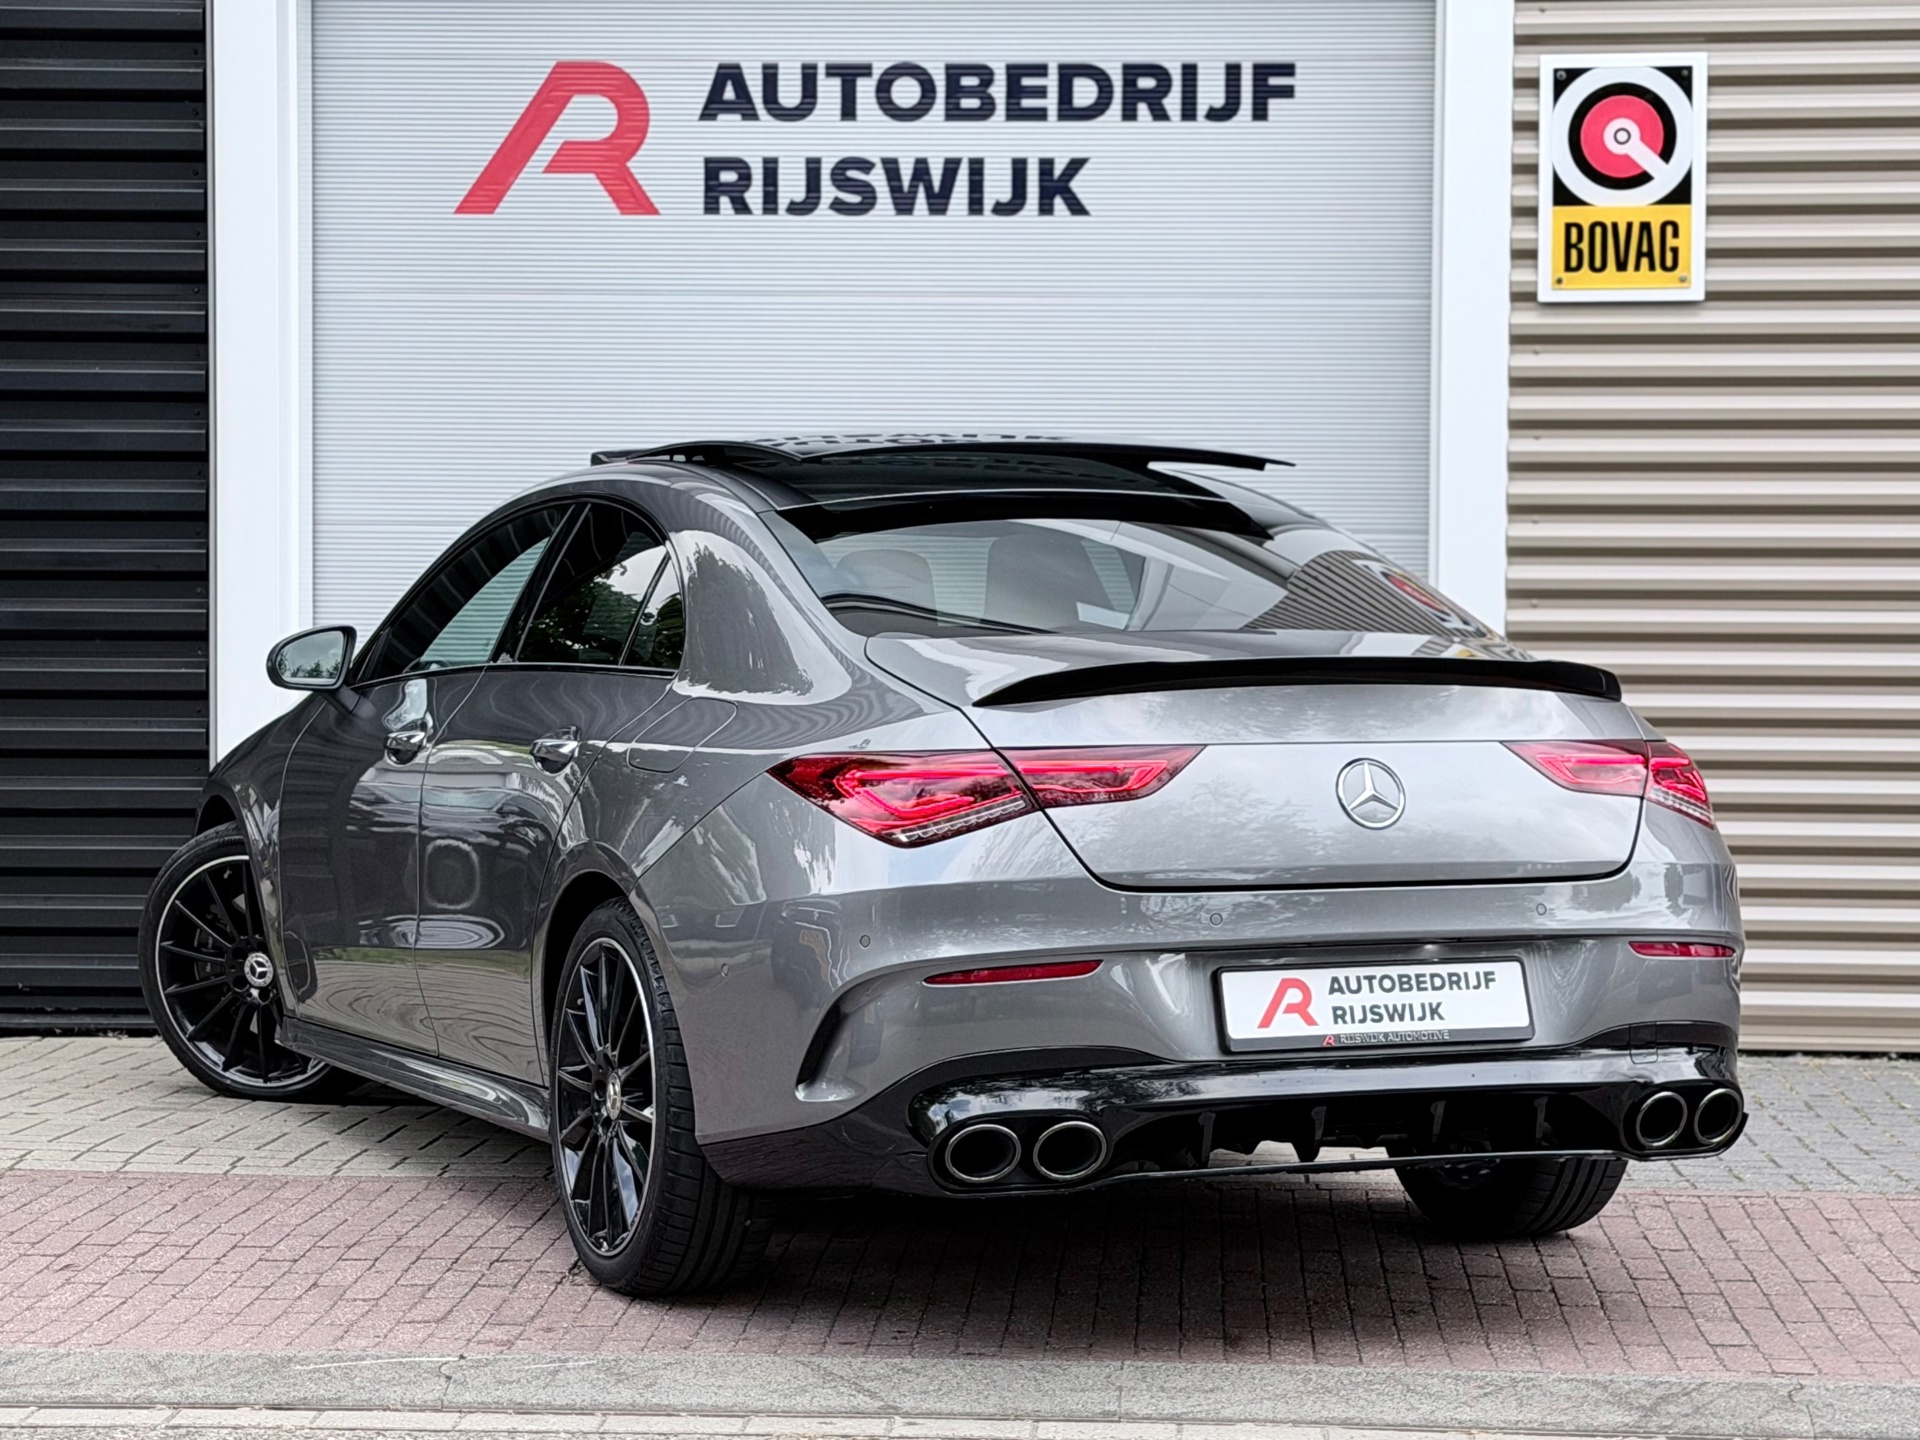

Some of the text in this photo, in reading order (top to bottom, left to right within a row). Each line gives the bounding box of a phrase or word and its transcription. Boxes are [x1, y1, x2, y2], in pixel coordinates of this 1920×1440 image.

[698, 61, 1296, 122] AUTOBEDRIJF
[703, 156, 1091, 217] RIJSWIJK
[1563, 220, 1680, 273] BOVAG
[1328, 971, 1497, 996] AUTOBEDRIJF
[1331, 1001, 1446, 1025] RIJSWIJK
[1340, 1030, 1450, 1044] RIJSWIJK AUTOMOTIVE
